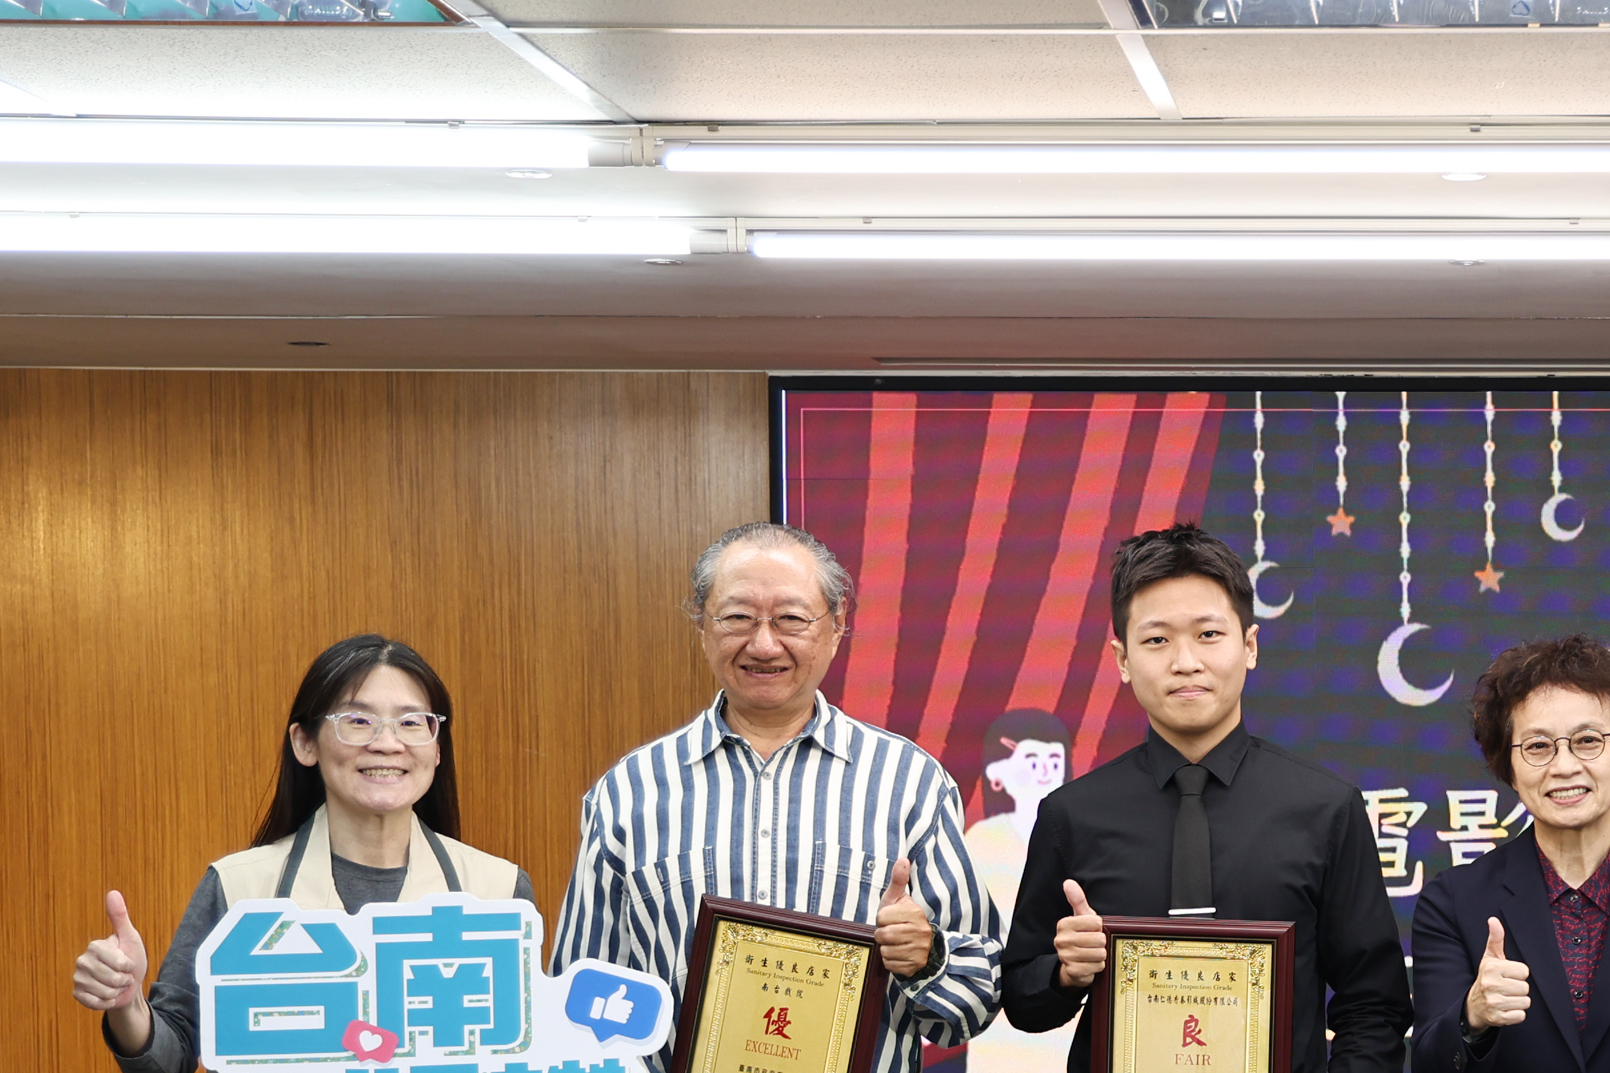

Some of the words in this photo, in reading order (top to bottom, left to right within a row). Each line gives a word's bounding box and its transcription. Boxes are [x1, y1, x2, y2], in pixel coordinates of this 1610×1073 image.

[745, 954, 830, 979] 衛生優良店家
[746, 968, 772, 978] Sanitary
[773, 973, 804, 983] Inspection
[1149, 969, 1237, 982] 衛生優良店家
[209, 905, 525, 1058] 台南
[1152, 982, 1178, 990] Sanitary
[763, 1006, 792, 1040] 優
[1182, 1014, 1207, 1048] 良
[745, 1039, 801, 1060] EXCELLENT
[1175, 1053, 1212, 1066] FAIR
